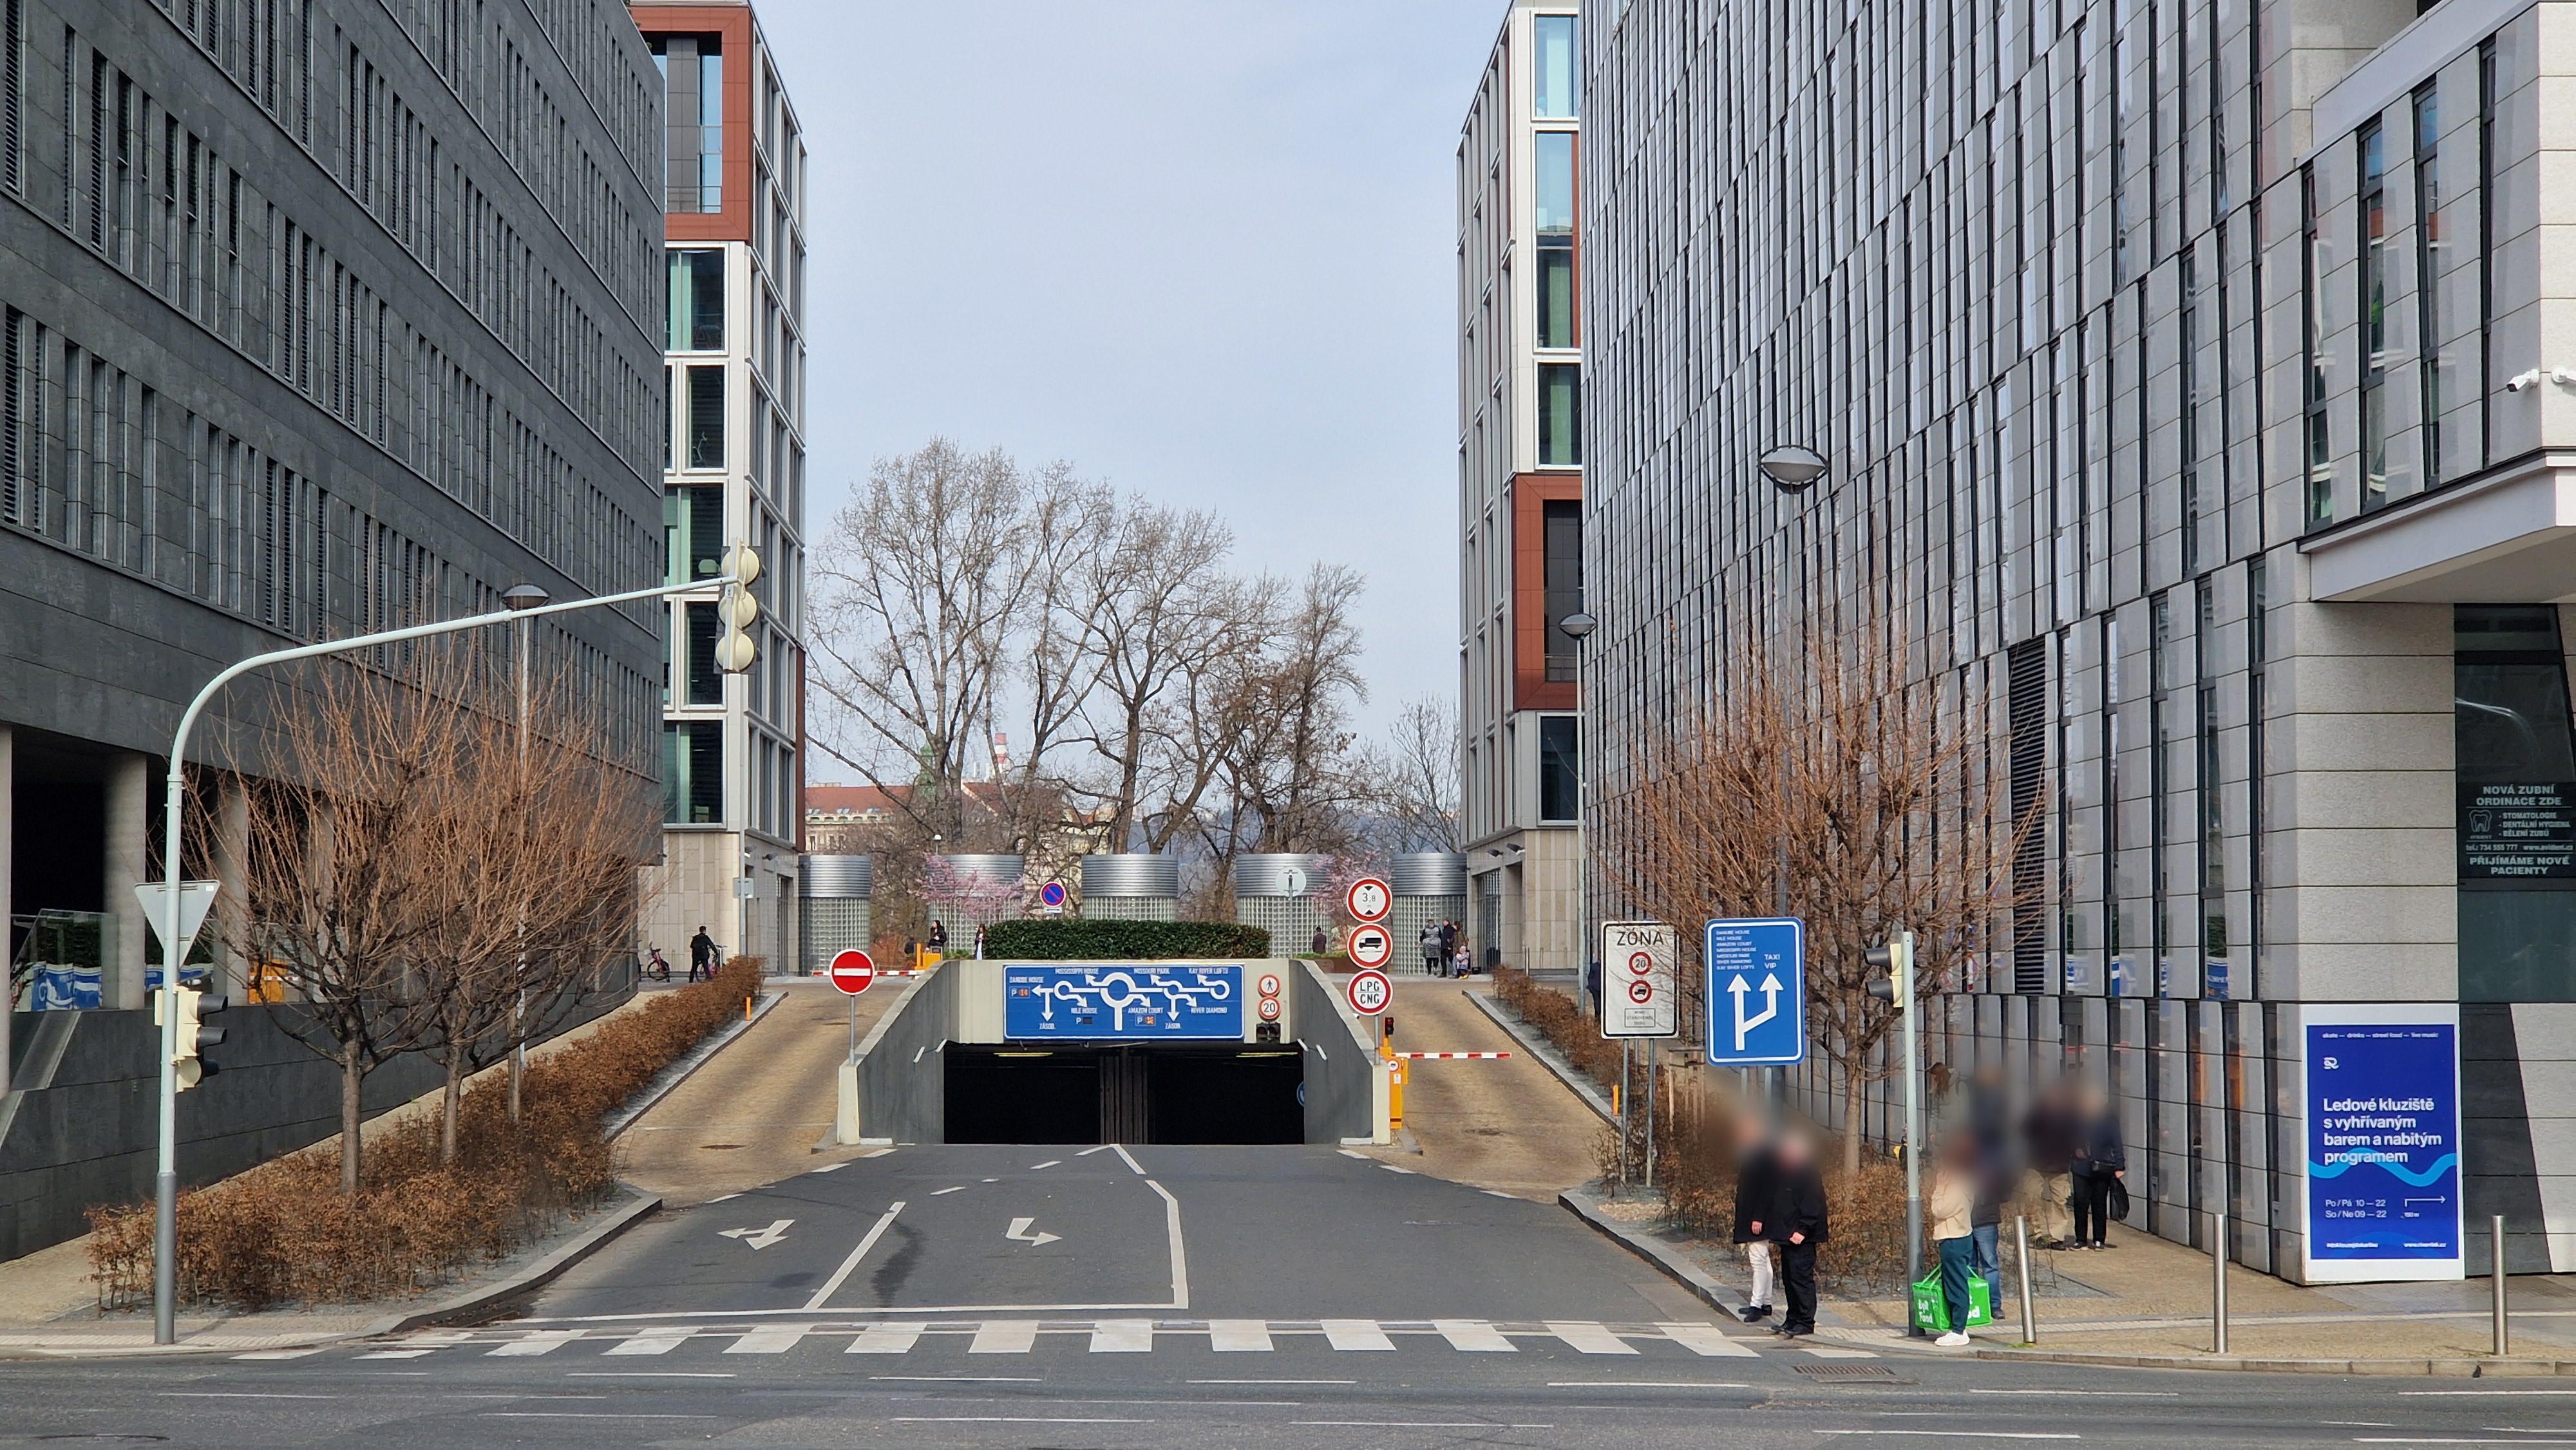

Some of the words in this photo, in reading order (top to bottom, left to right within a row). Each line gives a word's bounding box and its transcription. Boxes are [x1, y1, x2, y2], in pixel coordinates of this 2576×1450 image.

[2483, 784, 2515, 794] NOVÁ
[2518, 784, 2555, 794] ZUBNÍ
[2476, 797, 2535, 805] ORDINACE
[2539, 796, 2562, 805] ZDE
[2470, 856, 2535, 865] PŘIJÍMÁME
[2537, 856, 2570, 865] NOVÉ
[2491, 867, 2549, 875] PACIENTY
[1616, 927, 1664, 947] ZÓNA
[1634, 959, 1646, 968] 20
[1359, 981, 1379, 992] LPG
[1360, 993, 1379, 1004] CNG
[1264, 1003, 1275, 1013] 20
[2324, 1097, 2377, 1112] Ledové
[2379, 1097, 2434, 1112] kluziště
[2324, 1118, 2333, 1129] s
[2335, 1115, 2416, 1131] vyhřívaným
[2324, 1133, 2371, 1146] barem
[2372, 1136, 2382, 1146] a
[2384, 1131, 2442, 1149] nabitým
[2324, 1151, 2409, 1166] programem
[2375, 1199, 2386, 1207] 22
[2376, 1210, 2387, 1218] 22
